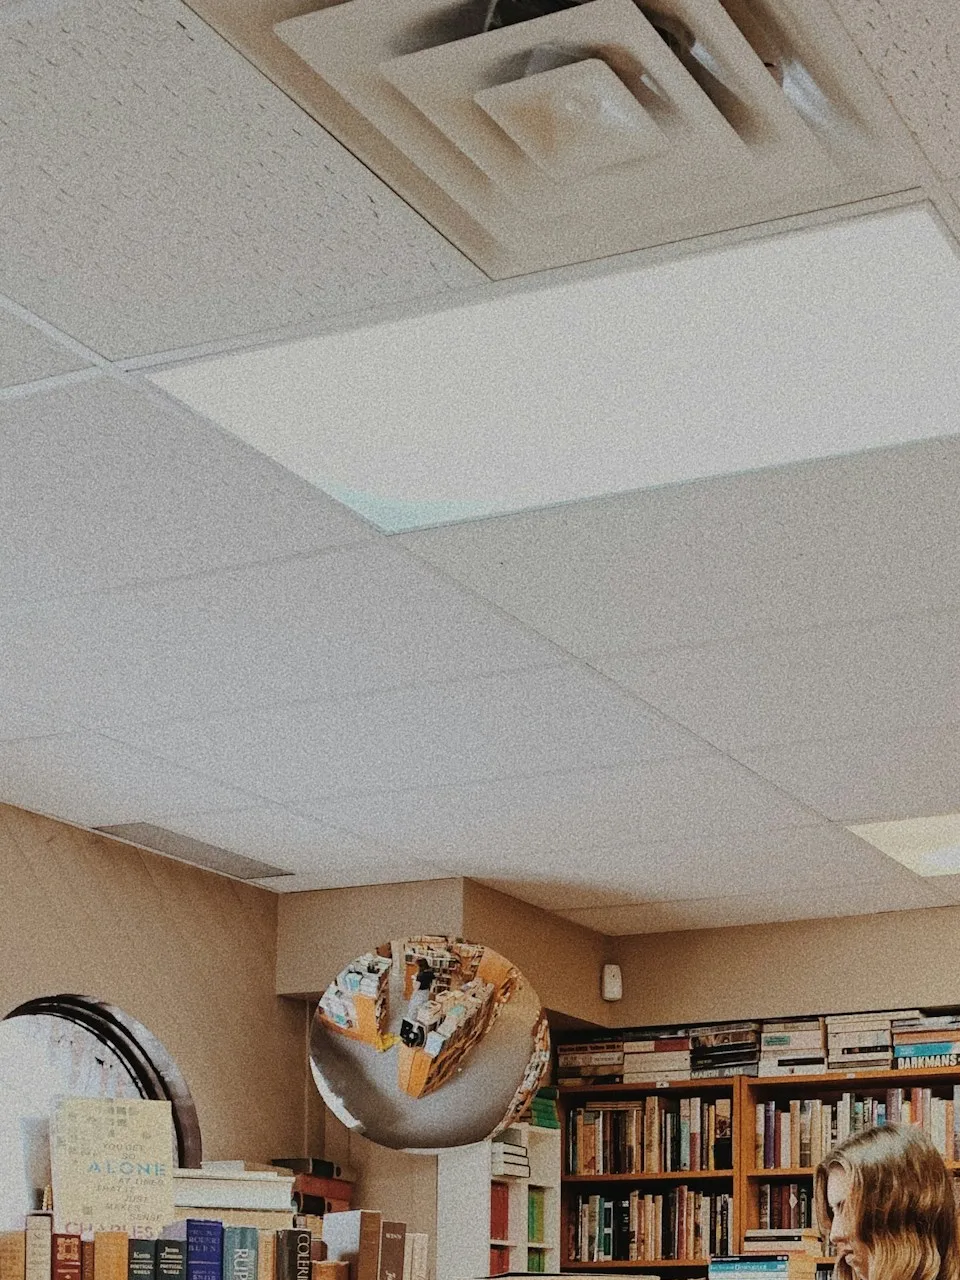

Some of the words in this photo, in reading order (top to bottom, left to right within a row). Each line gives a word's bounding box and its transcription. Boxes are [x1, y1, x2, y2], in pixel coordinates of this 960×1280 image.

[897, 1054, 957, 1069] DARKMANS
[722, 1065, 742, 1075] AMIS
[88, 1161, 165, 1176] ALONE
